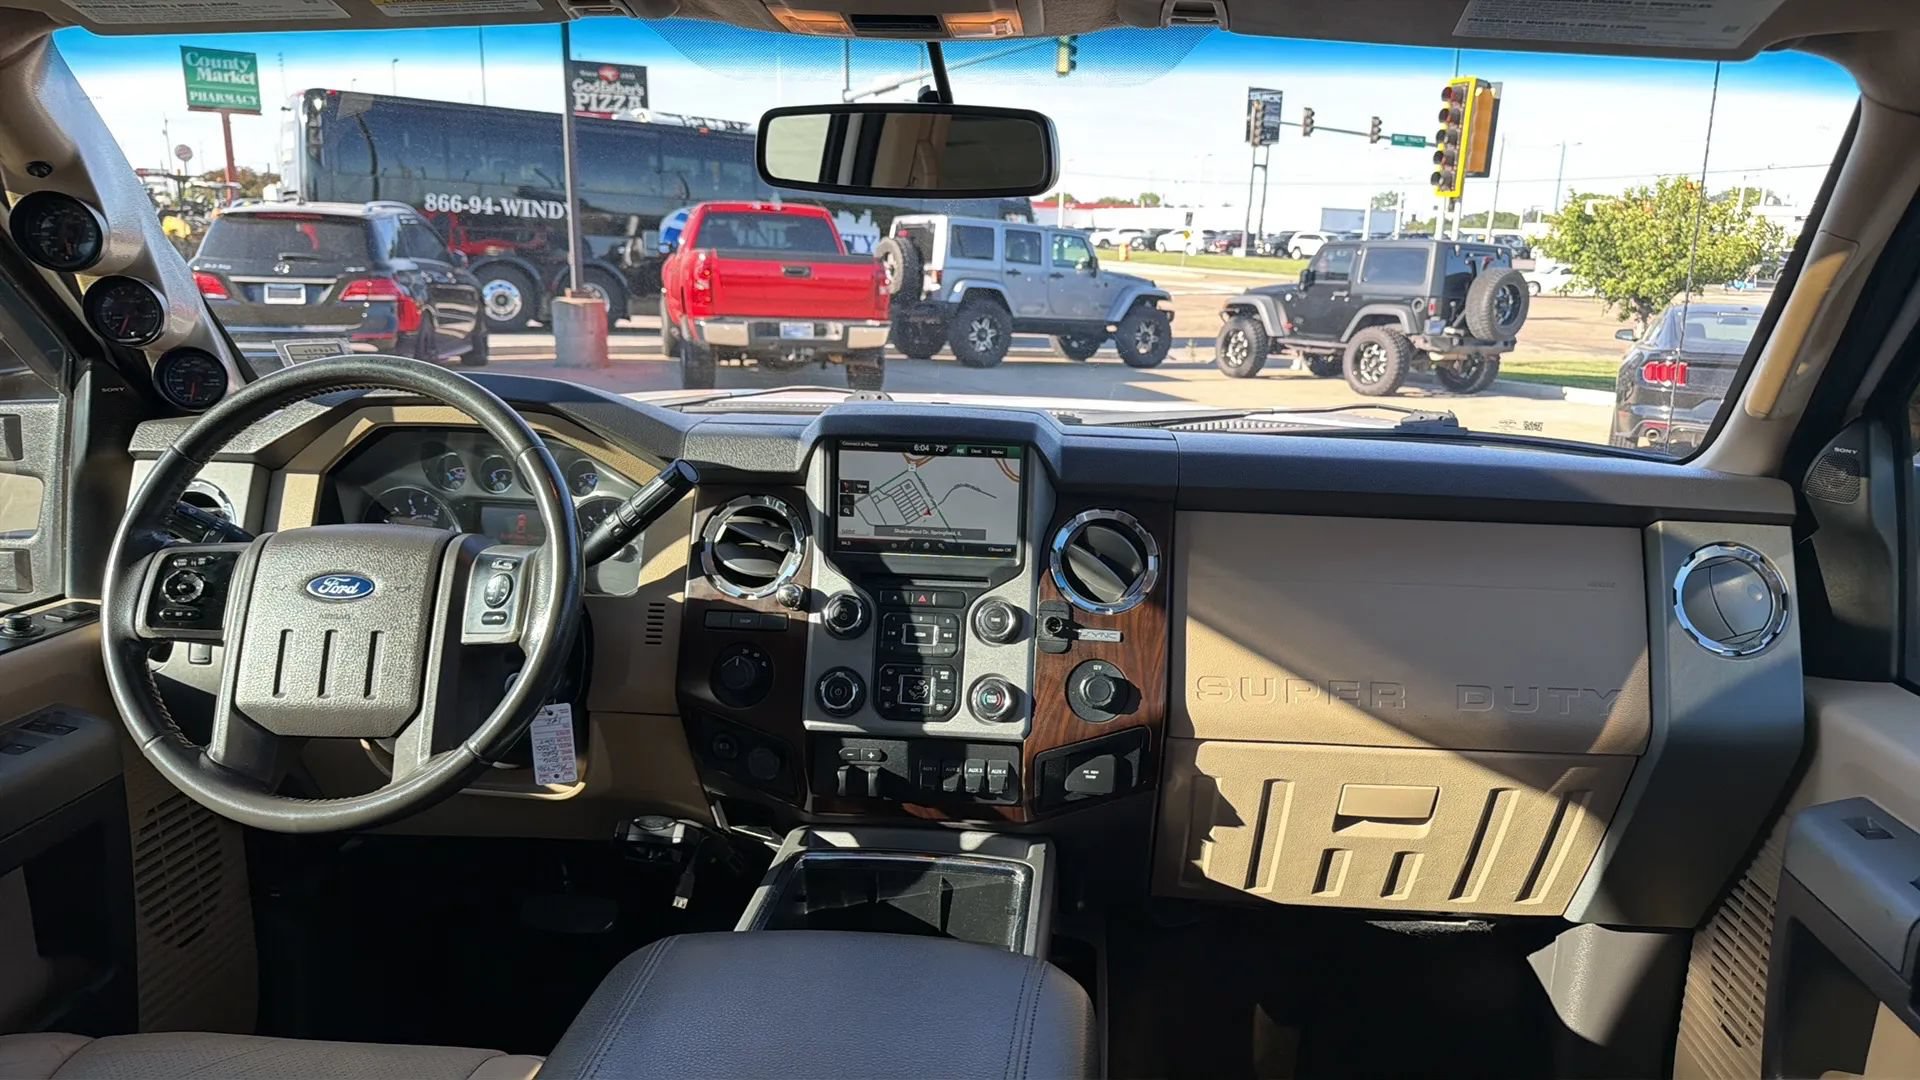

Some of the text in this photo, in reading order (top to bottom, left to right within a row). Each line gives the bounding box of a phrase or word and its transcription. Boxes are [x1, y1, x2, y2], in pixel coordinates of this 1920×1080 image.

[185, 51, 250, 73] County
[196, 67, 256, 85] Market
[189, 91, 257, 105] PHARMACY
[573, 92, 642, 112] PIZZA
[913, 443, 930, 452] 6:04
[1833, 447, 1858, 455] SONY
[317, 576, 361, 595] Ford
[1196, 675, 1406, 710] SUPER
[1456, 684, 1625, 716] DUTY
